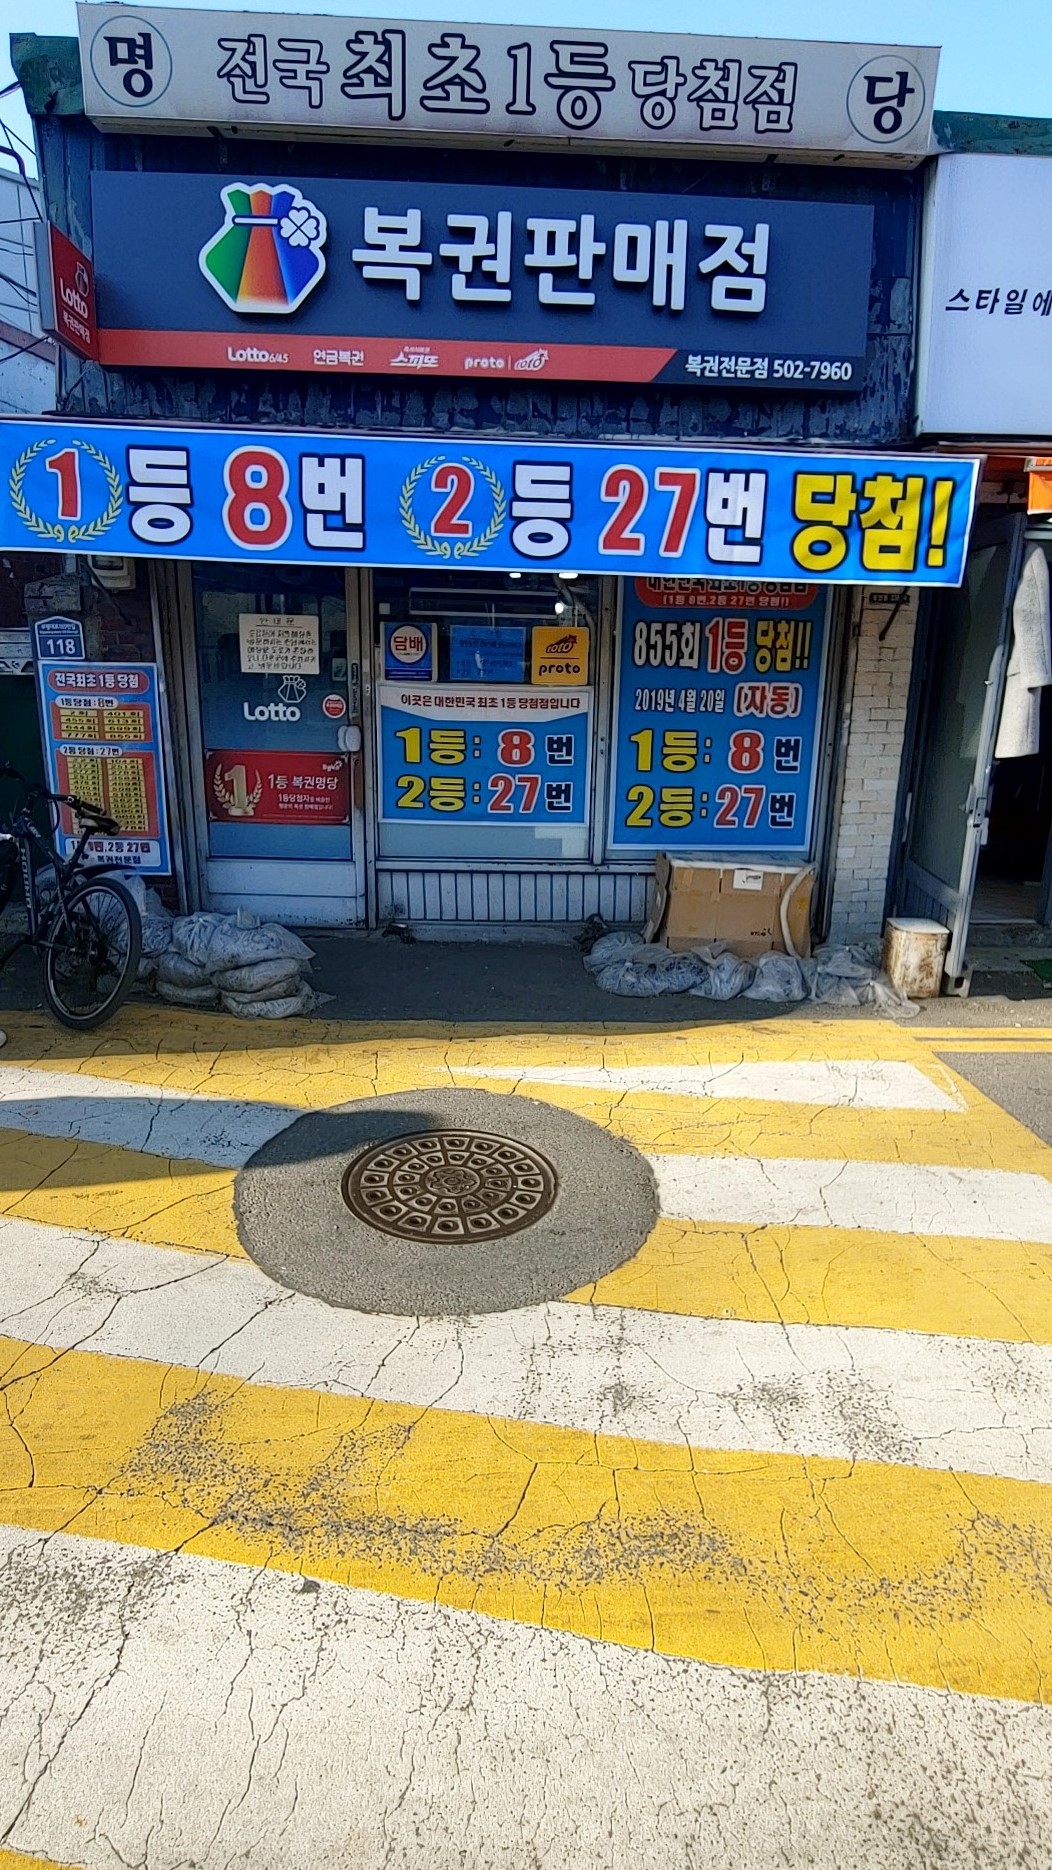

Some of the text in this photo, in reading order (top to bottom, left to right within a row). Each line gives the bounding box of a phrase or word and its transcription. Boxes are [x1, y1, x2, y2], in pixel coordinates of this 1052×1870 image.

[103, 31, 154, 99] 명
[862, 70, 915, 135] 당
[352, 207, 771, 314] 복권판매점
[60, 276, 89, 319] Lotto
[313, 348, 364, 366] 연금복권
[390, 351, 439, 369] 스피또
[464, 356, 505, 370] proto
[685, 354, 852, 381] 복권전문점 502-7960
[598, 464, 768, 565] 27번
[791, 472, 956, 572] 당첨!
[47, 639, 76, 655] 118
[393, 635, 424, 652] 담배
[633, 617, 813, 674] 855회 1등 당첨!!
[539, 662, 581, 676] proto
[55, 672, 139, 689] 전국최초 1등 당첨
[401, 694, 581, 710] 이곳은 대한민국 최초 1등 당첨점입니다
[634, 681, 803, 719] 2019년 4월 20일 (자동)
[243, 701, 301, 722] Lotto
[268, 773, 339, 790] 1등 복권명당
